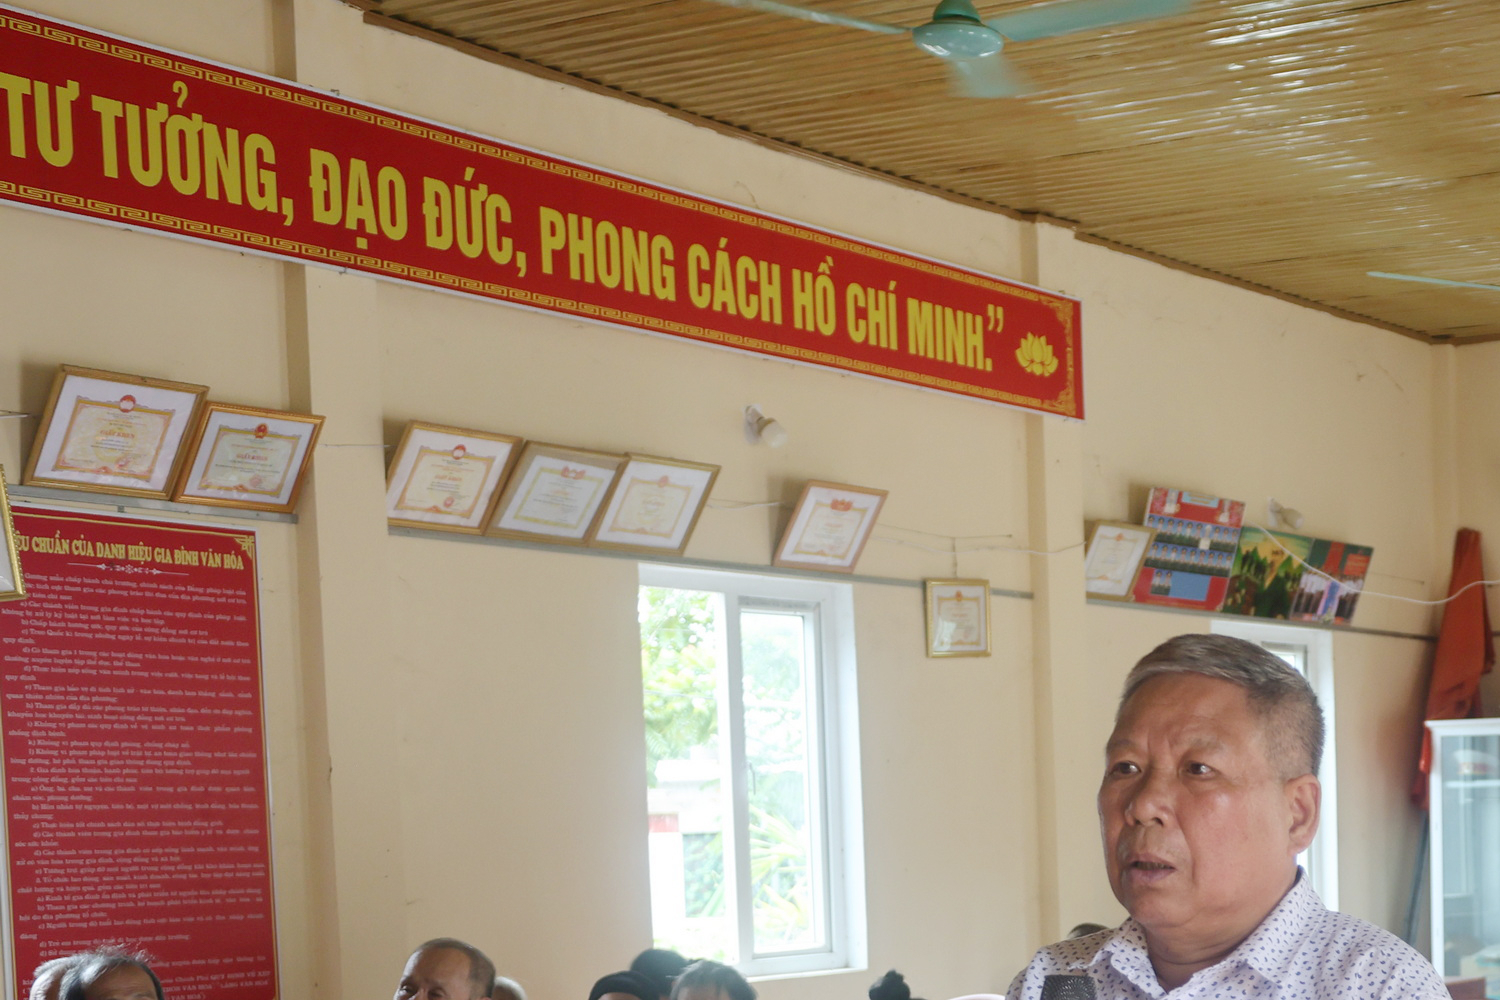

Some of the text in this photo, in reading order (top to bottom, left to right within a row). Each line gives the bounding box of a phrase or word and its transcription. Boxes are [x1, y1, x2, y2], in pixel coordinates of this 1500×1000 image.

[0, 72, 80, 167] TƯ
[92, 80, 294, 226] TƯỞNG,
[309, 148, 408, 249] ĐẠO
[422, 166, 527, 278] ĐỨC,
[540, 206, 676, 302] PHONG
[687, 237, 783, 325] CÁCH
[792, 256, 836, 336] HỒ
[846, 280, 898, 351] CHÍ
[32, 530, 70, 554] CHUẨN
[72, 534, 95, 557] CỦA
[96, 541, 126, 559] DANH
[128, 541, 152, 564] HIỆU
[154, 547, 173, 565] GIA
[174, 546, 199, 566] ĐÌNH
[201, 548, 222, 567] VĂN
[224, 551, 244, 570] HÓA
